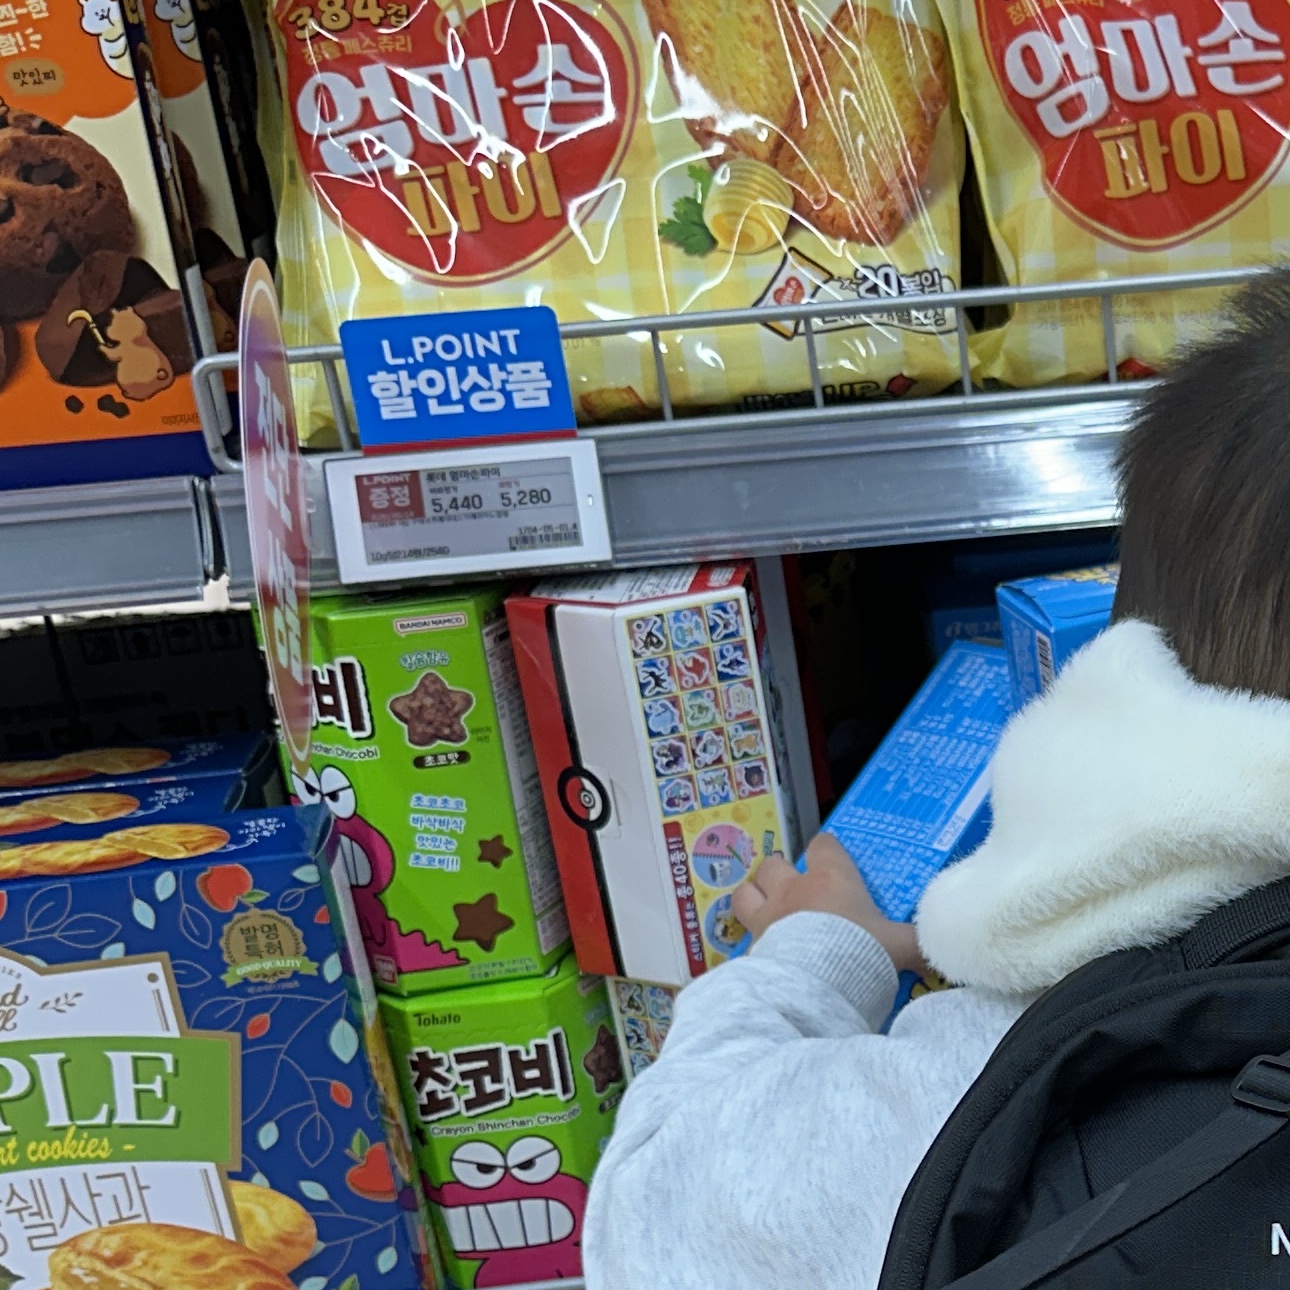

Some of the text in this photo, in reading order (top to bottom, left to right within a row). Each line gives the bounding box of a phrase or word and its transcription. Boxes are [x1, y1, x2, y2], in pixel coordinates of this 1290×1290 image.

[1005, 2, 1286, 138] 엄마손
[297, 43, 612, 176] 엄마손
[1093, 109, 1247, 200] 파이
[403, 152, 563, 241] 파이
[381, 329, 520, 367] L.POINT
[367, 362, 553, 421] 할인상품
[369, 485, 412, 510] 증정
[432, 488, 552, 515] 5,440 5,280
[411, 816, 464, 833] 바삭바삭
[417, 835, 457, 851] 맛있는
[413, 1013, 461, 1027] Tohato
[409, 1031, 574, 1118] 초코비
[27, 1125, 112, 1162] cookies
[431, 1124, 474, 1137] Crayon
